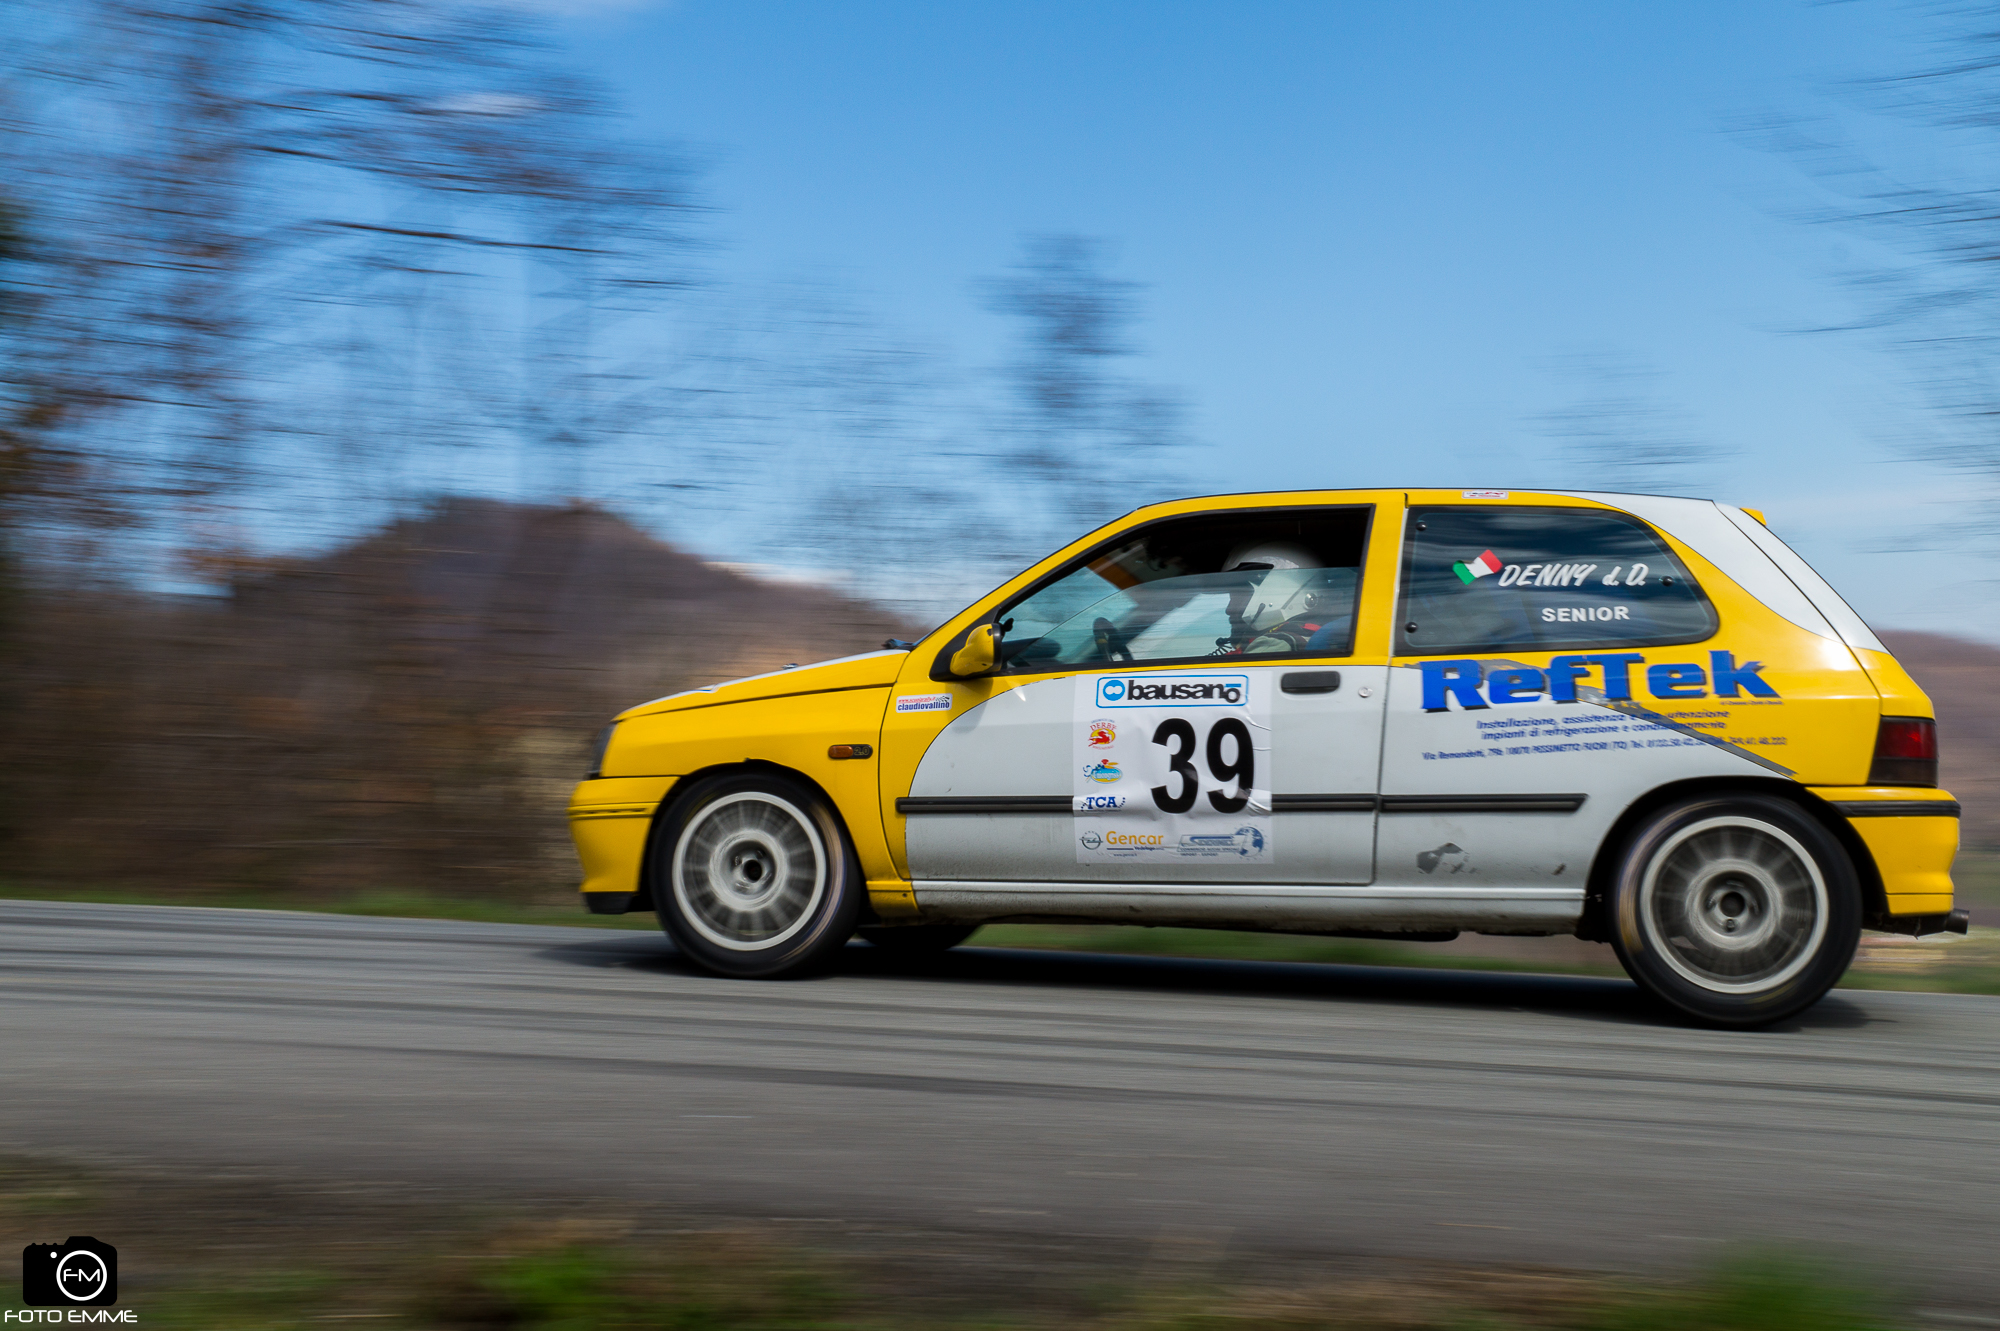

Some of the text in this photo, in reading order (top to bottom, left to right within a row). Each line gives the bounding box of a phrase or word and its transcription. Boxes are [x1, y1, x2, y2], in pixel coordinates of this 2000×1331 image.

[1498, 563, 1597, 587] DENNY
[1541, 606, 1630, 622] SENIOR
[1419, 650, 1781, 712] RefTek
[1127, 680, 1241, 703] bausano
[897, 701, 950, 711] claudiovallino
[1090, 722, 1117, 732] DERBY
[1481, 729, 1526, 741] impianti
[853, 746, 870, 756] 2.0
[1151, 717, 1254, 814] 39
[1086, 796, 1118, 810] TCA
[1105, 830, 1165, 846] Gencar
